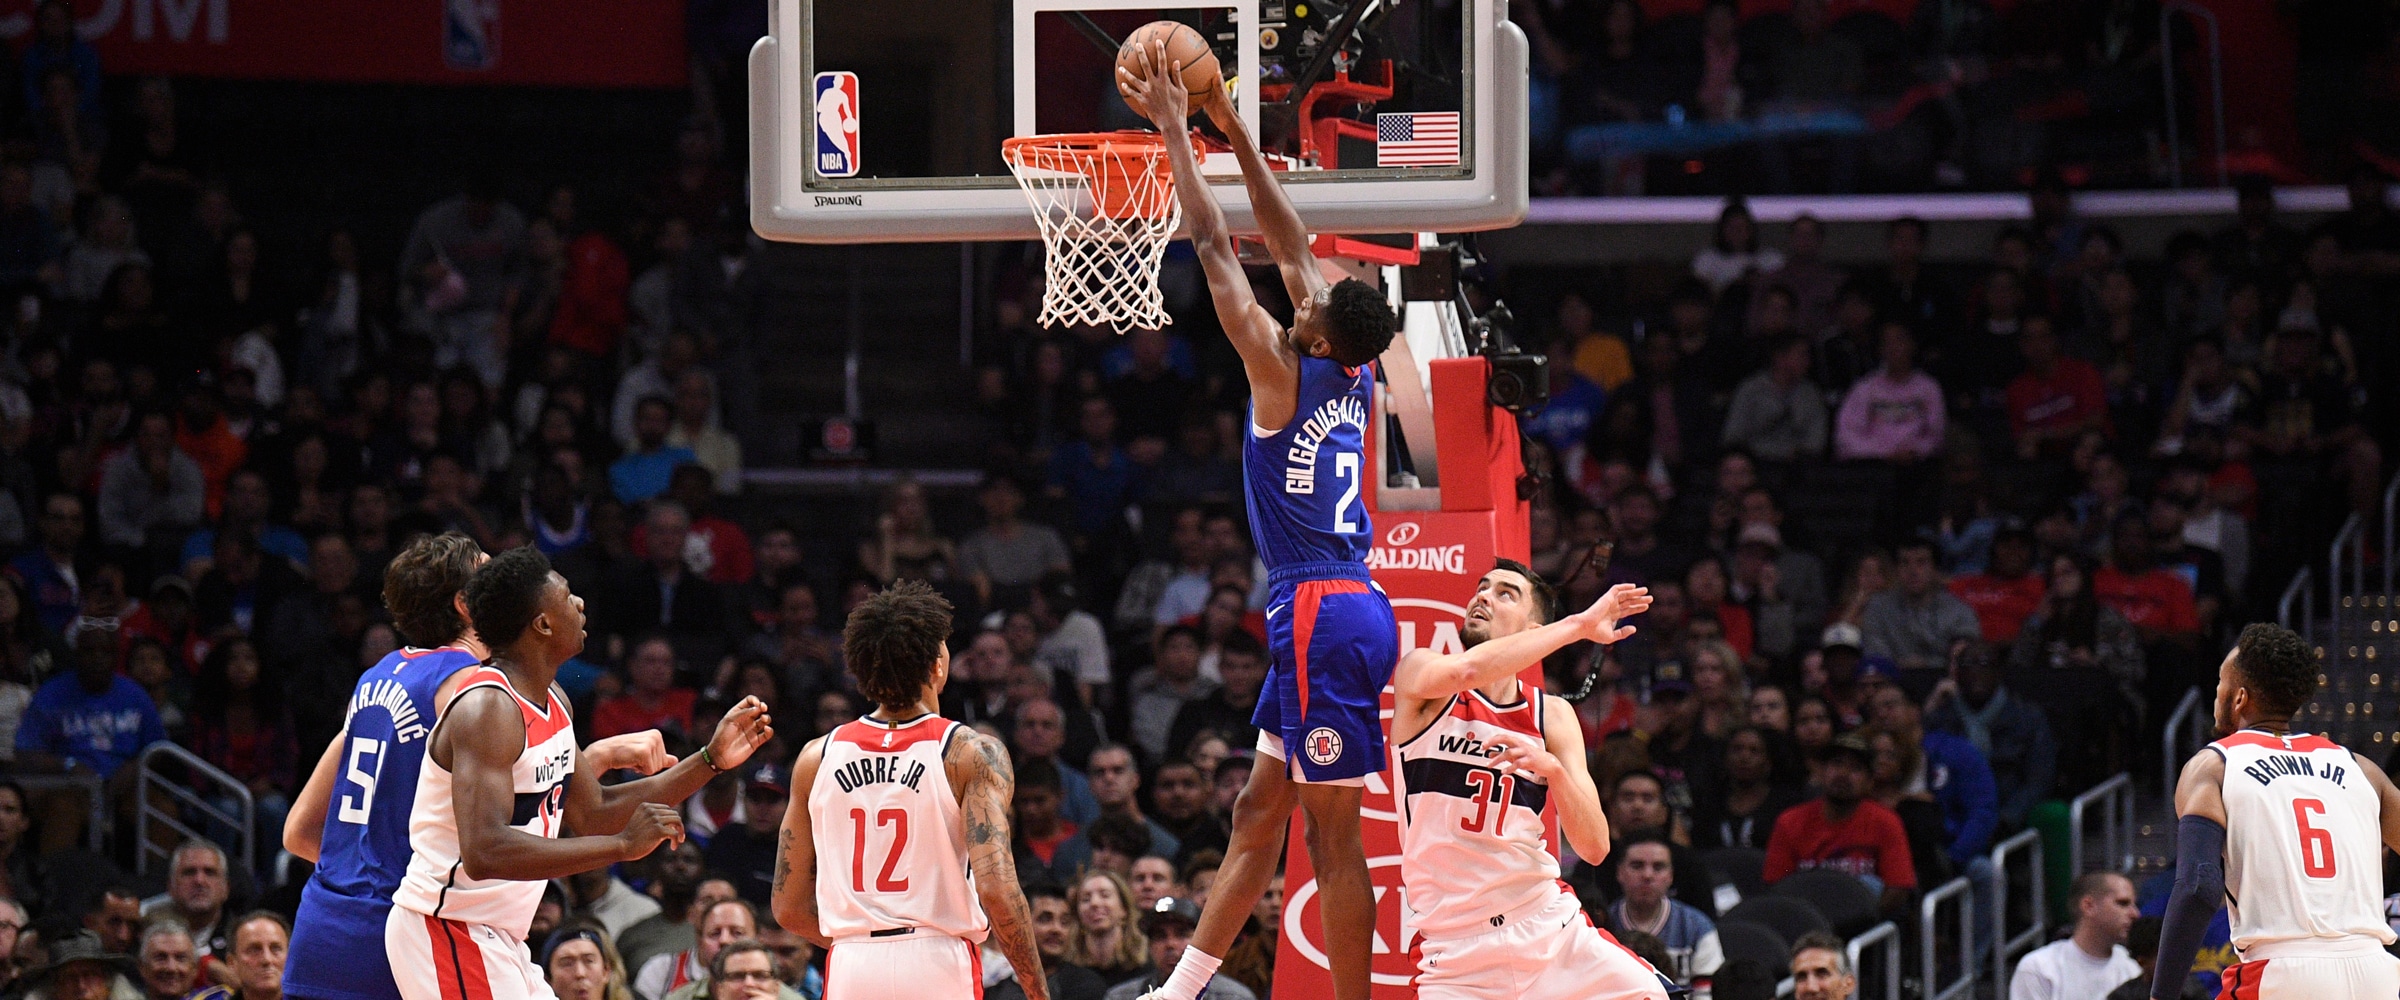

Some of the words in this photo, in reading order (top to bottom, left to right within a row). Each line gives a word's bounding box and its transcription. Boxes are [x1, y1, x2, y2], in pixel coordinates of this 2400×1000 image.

[821, 152, 843, 170] NBA
[814, 195, 862, 207] SPALDING
[1334, 452, 1359, 533] 2
[834, 756, 899, 793] OUBRE
[900, 760, 926, 794] JR.
[2244, 755, 2315, 786] BROWN
[2320, 763, 2346, 790] JR.
[1461, 770, 1514, 837] 31
[850, 808, 909, 892] 12
[2292, 798, 2337, 879] 6
